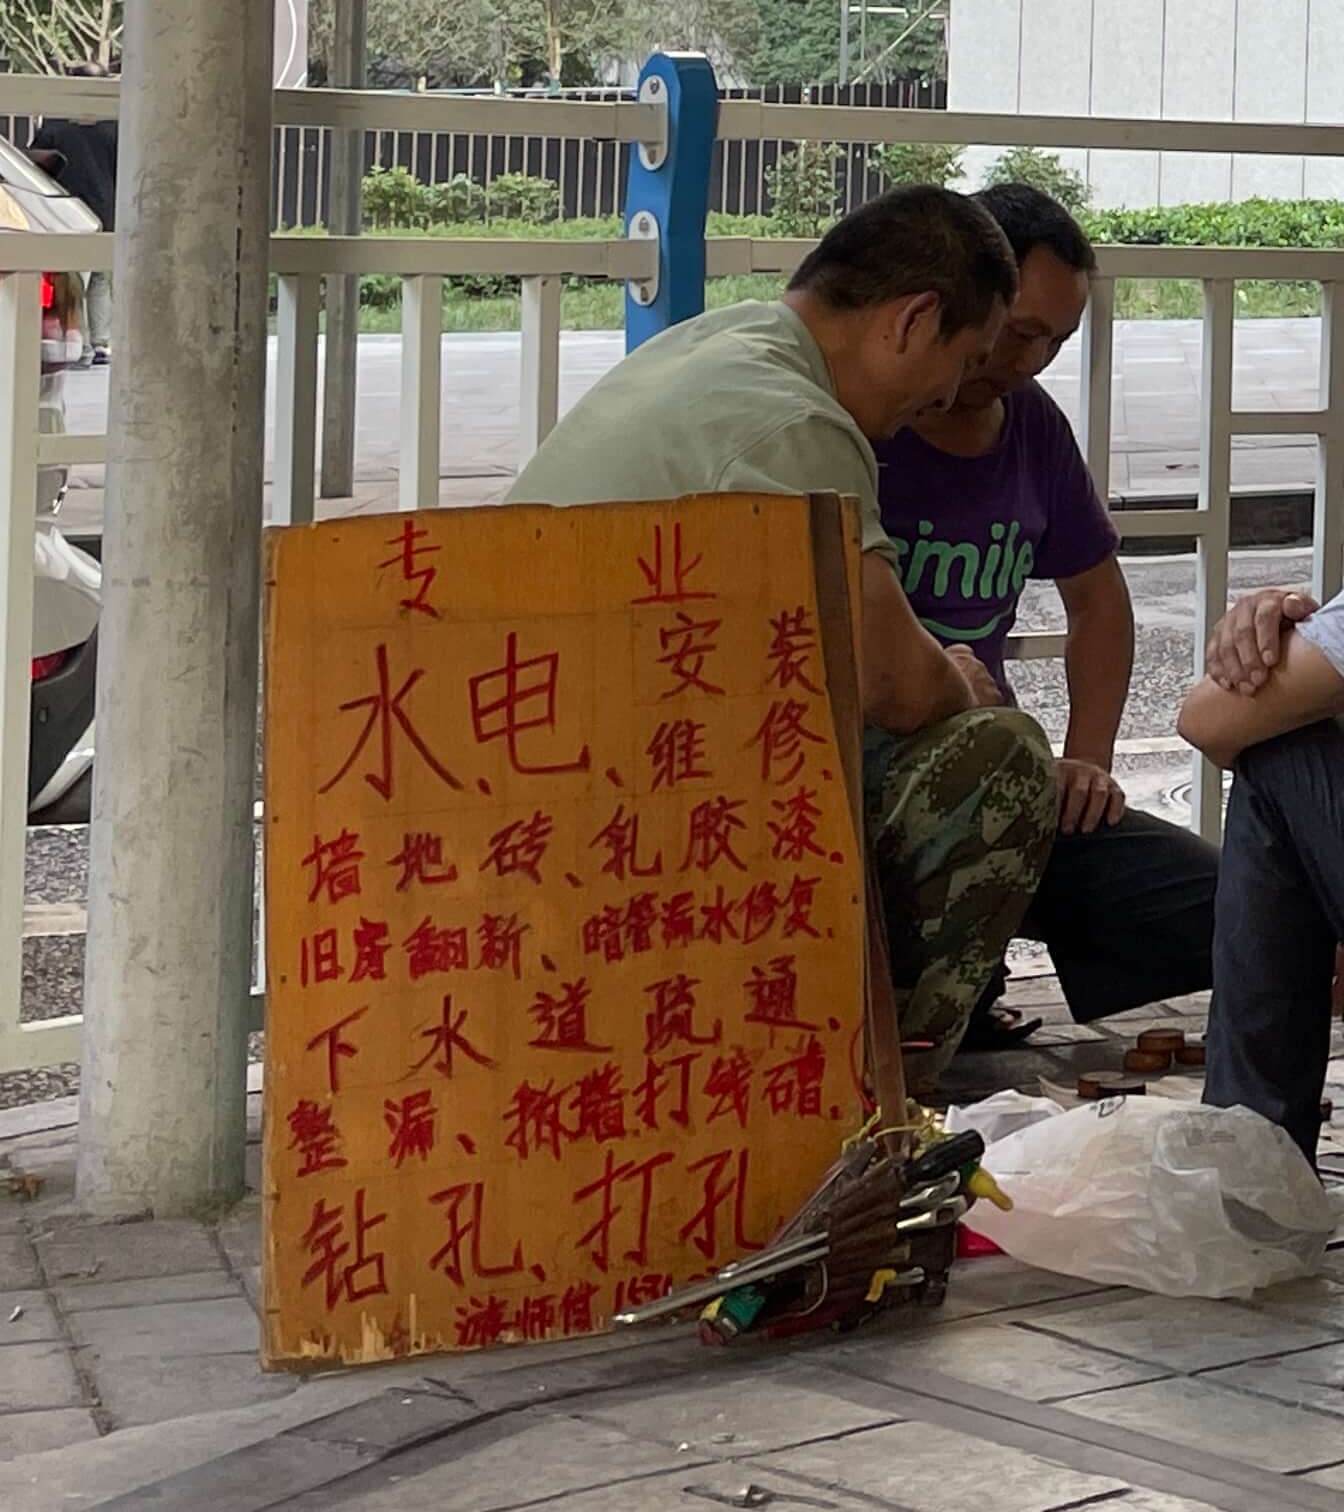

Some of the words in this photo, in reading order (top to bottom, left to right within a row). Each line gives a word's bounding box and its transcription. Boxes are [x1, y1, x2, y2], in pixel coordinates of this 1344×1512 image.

[379, 520, 717, 619] 专业
[888, 520, 1034, 599] mile
[657, 606, 825, 699] 安装
